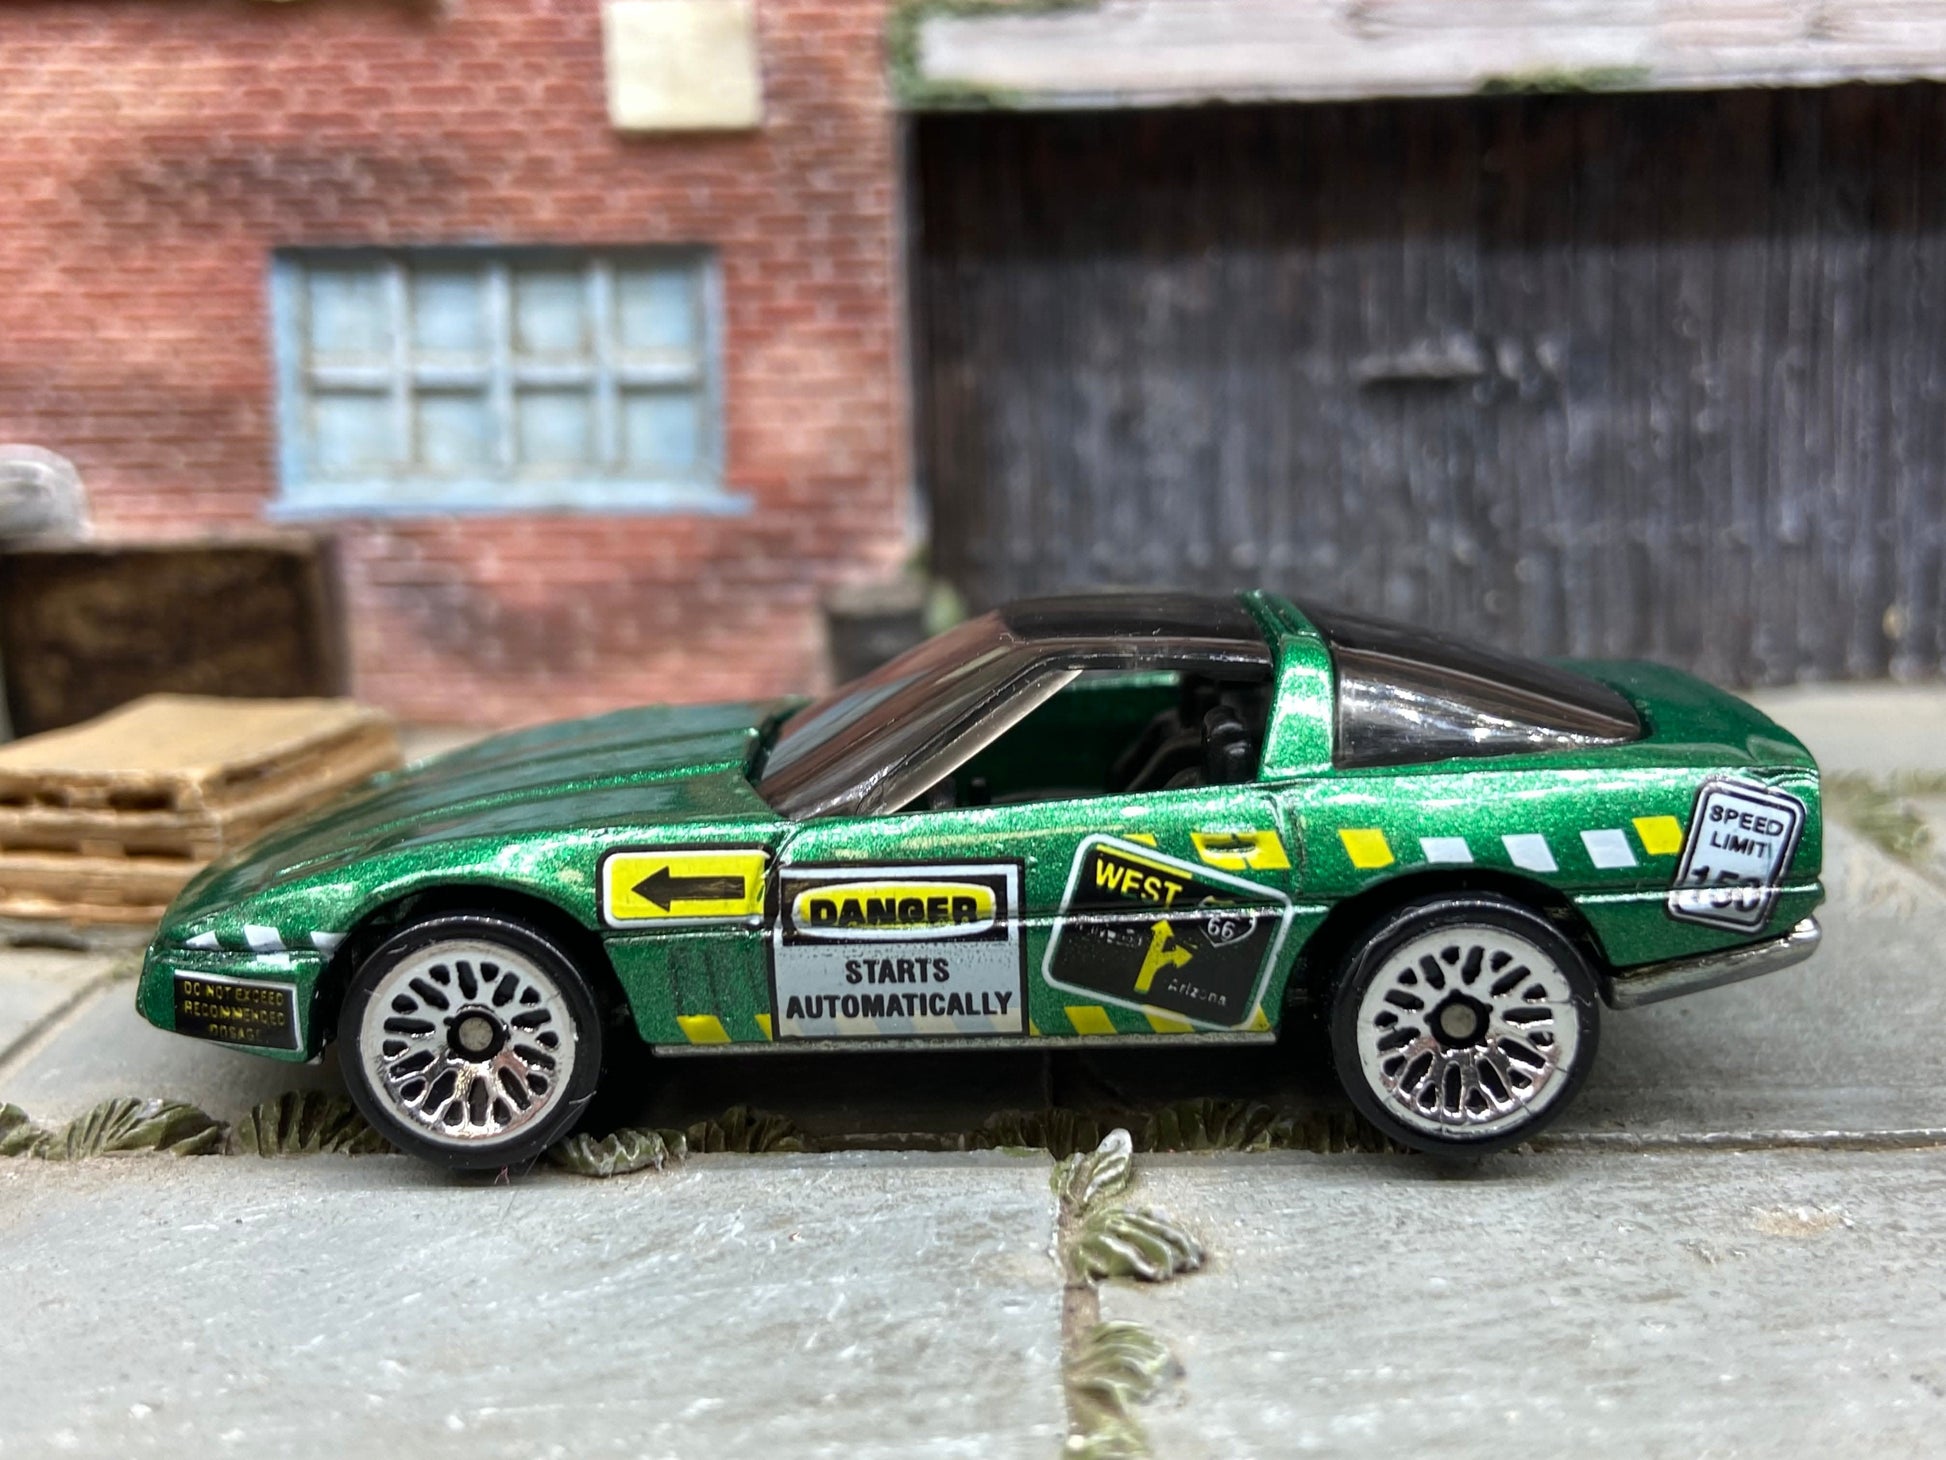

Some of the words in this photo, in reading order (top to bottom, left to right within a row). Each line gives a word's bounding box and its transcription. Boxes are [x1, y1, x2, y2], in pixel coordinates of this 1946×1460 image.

[1709, 804, 1784, 836] SPEED
[1710, 831, 1768, 858] LIMIT
[1095, 857, 1183, 907] WEST
[809, 896, 978, 928] DANGER
[1206, 918, 1236, 941] 66
[845, 958, 950, 984] STARTS
[183, 980, 201, 996] DO
[205, 985, 232, 1001] NOT
[235, 987, 284, 1006] EXCEED
[785, 991, 1013, 1019] AUTOMATICALLY
[183, 1000, 286, 1026] RECOMMENDED
